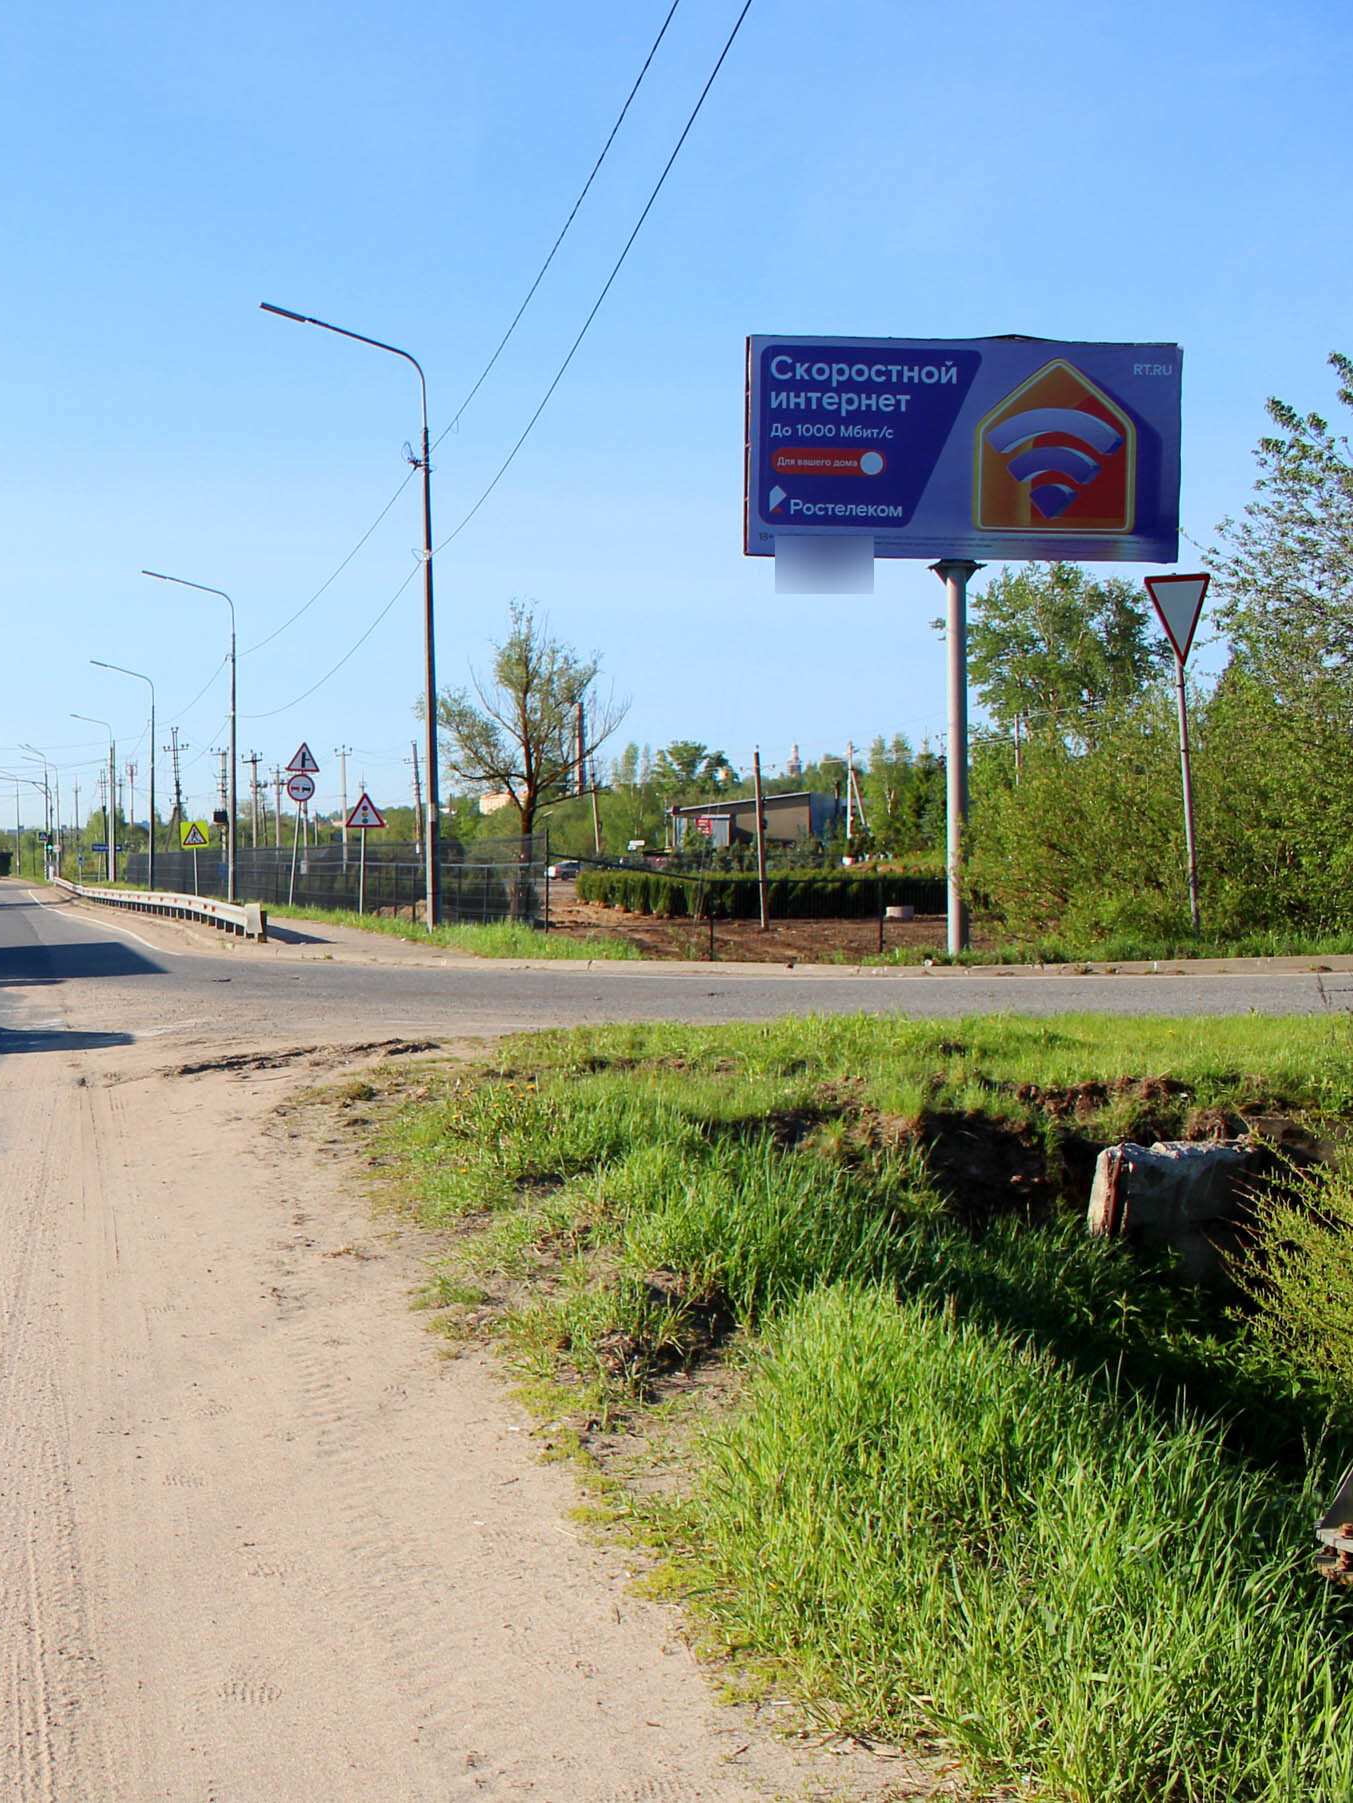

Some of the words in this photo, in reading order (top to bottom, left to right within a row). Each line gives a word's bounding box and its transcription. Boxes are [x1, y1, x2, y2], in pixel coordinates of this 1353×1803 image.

[770, 355, 958, 387] Скоростной
[1133, 363, 1173, 376] RT.RU
[770, 391, 911, 416] интернет
[770, 423, 792, 438] До
[796, 424, 835, 437] 1000
[840, 425, 894, 439] Мбит/с
[777, 456, 795, 467] Для
[797, 458, 831, 467] вашего
[832, 459, 858, 468] дома
[790, 499, 903, 517] Ростелеком
